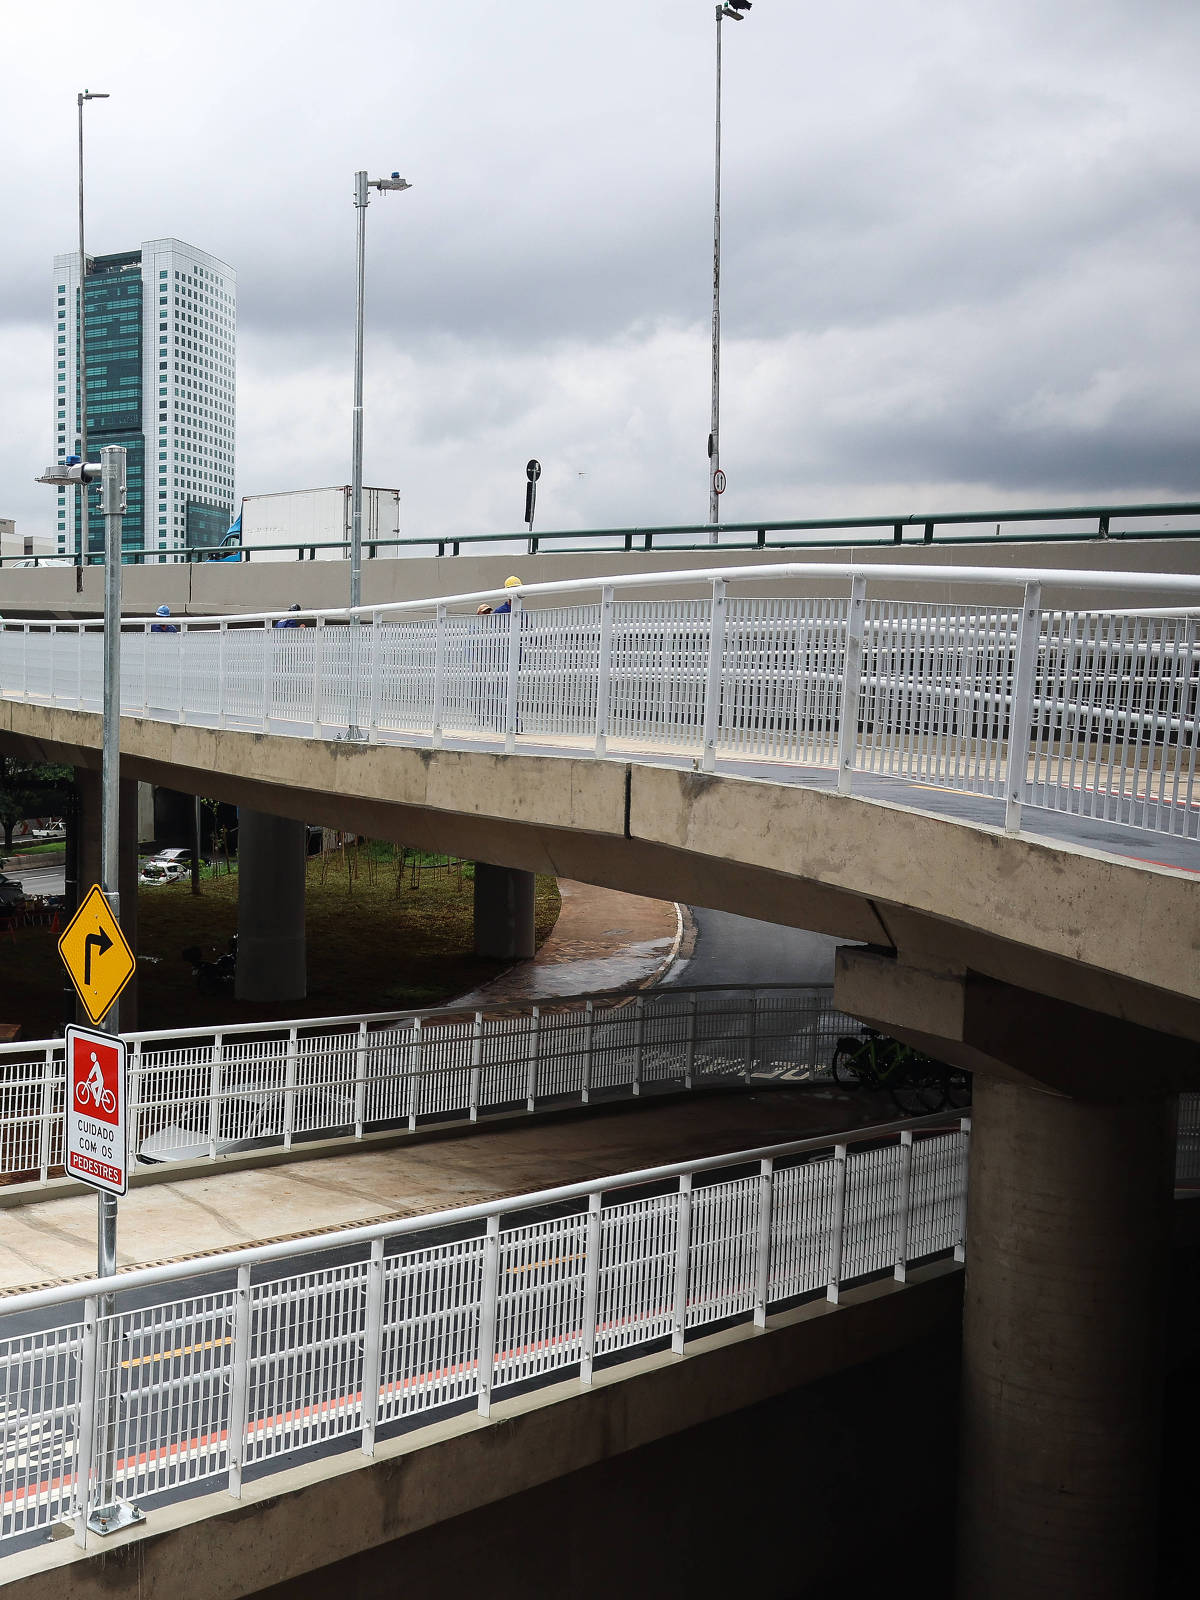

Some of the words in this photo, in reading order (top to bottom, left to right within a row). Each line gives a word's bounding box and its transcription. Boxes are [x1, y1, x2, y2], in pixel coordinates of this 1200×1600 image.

[78, 1119, 114, 1142] CUIDADO
[79, 1137, 97, 1153] COM
[102, 1145, 113, 1159] OS
[73, 1154, 119, 1181] PEDESTRES
